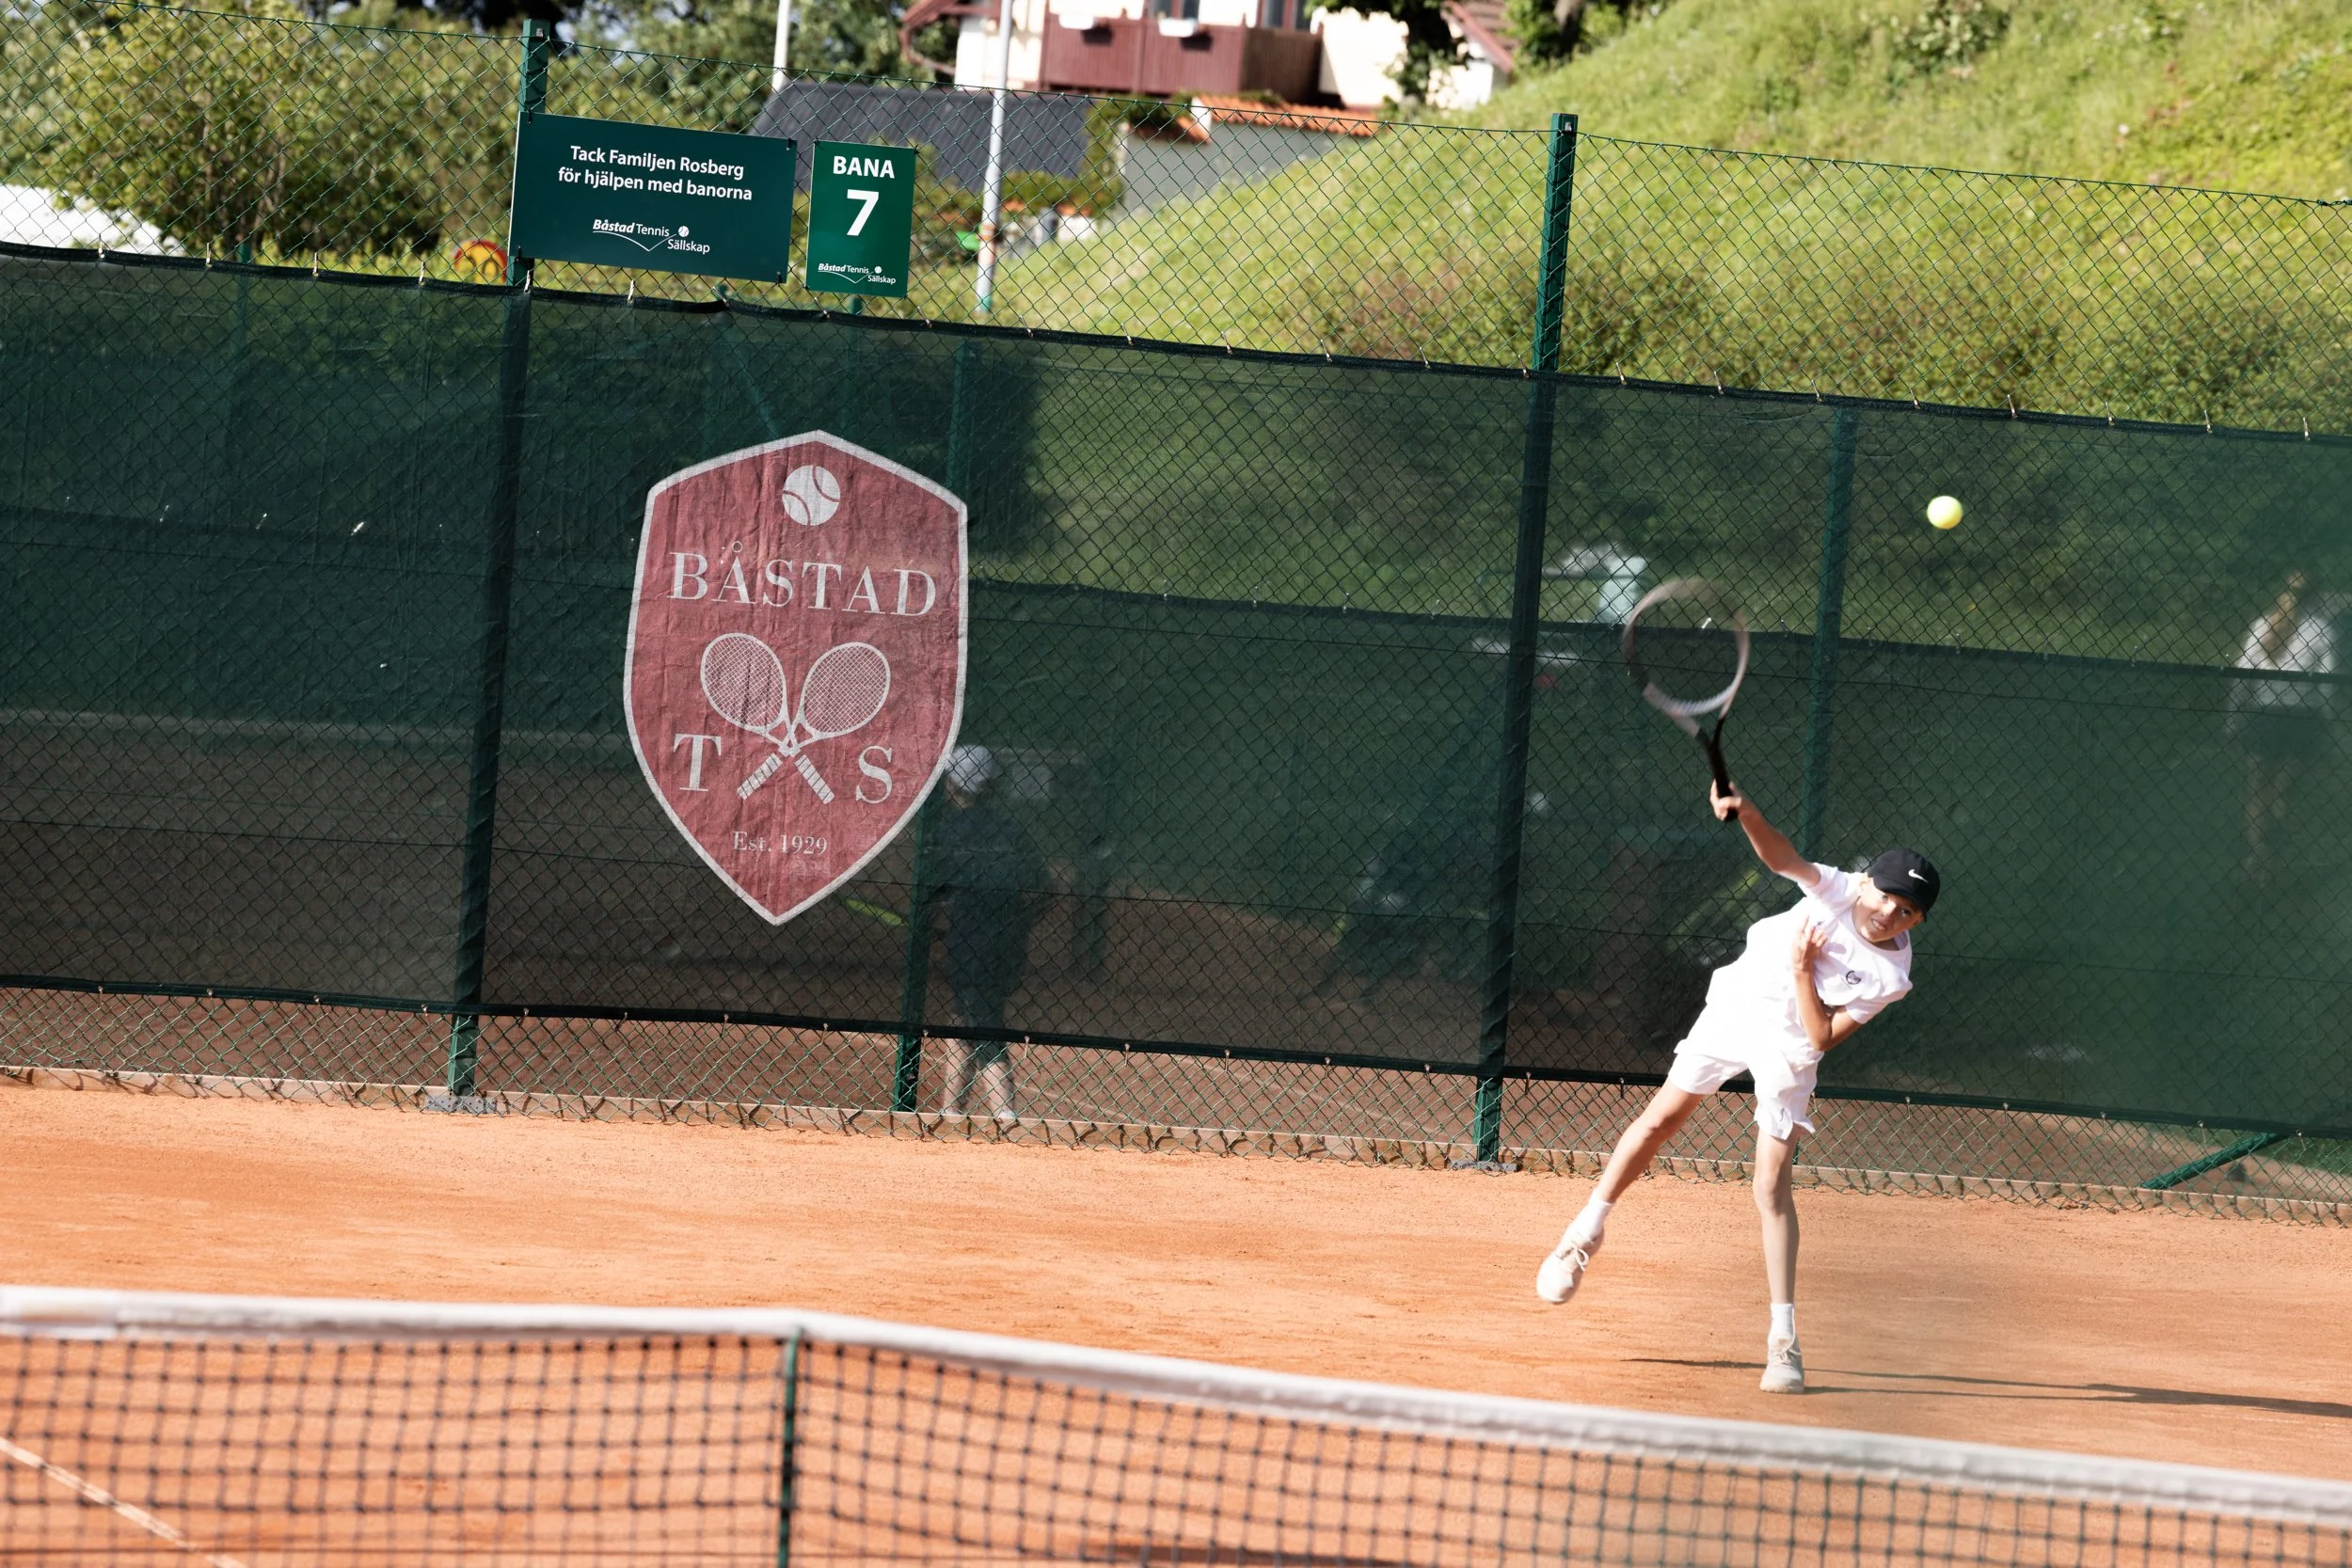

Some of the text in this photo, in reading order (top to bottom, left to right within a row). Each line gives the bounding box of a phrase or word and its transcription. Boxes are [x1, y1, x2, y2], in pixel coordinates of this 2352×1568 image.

[570, 145, 744, 181] Tack Familjen Rosberg
[833, 155, 895, 179] BANA
[558, 166, 753, 200] för hjälpen med banorna
[847, 189, 880, 236] 7
[592, 219, 670, 237] Båstad Tennis
[667, 239, 710, 255] Sällskap
[818, 263, 869, 274] Båstad Tennis
[867, 274, 897, 285] Sällskap
[667, 541, 937, 617] BÅSTAD
[673, 733, 895, 804] T S
[732, 831, 828, 856] Est. 1929
